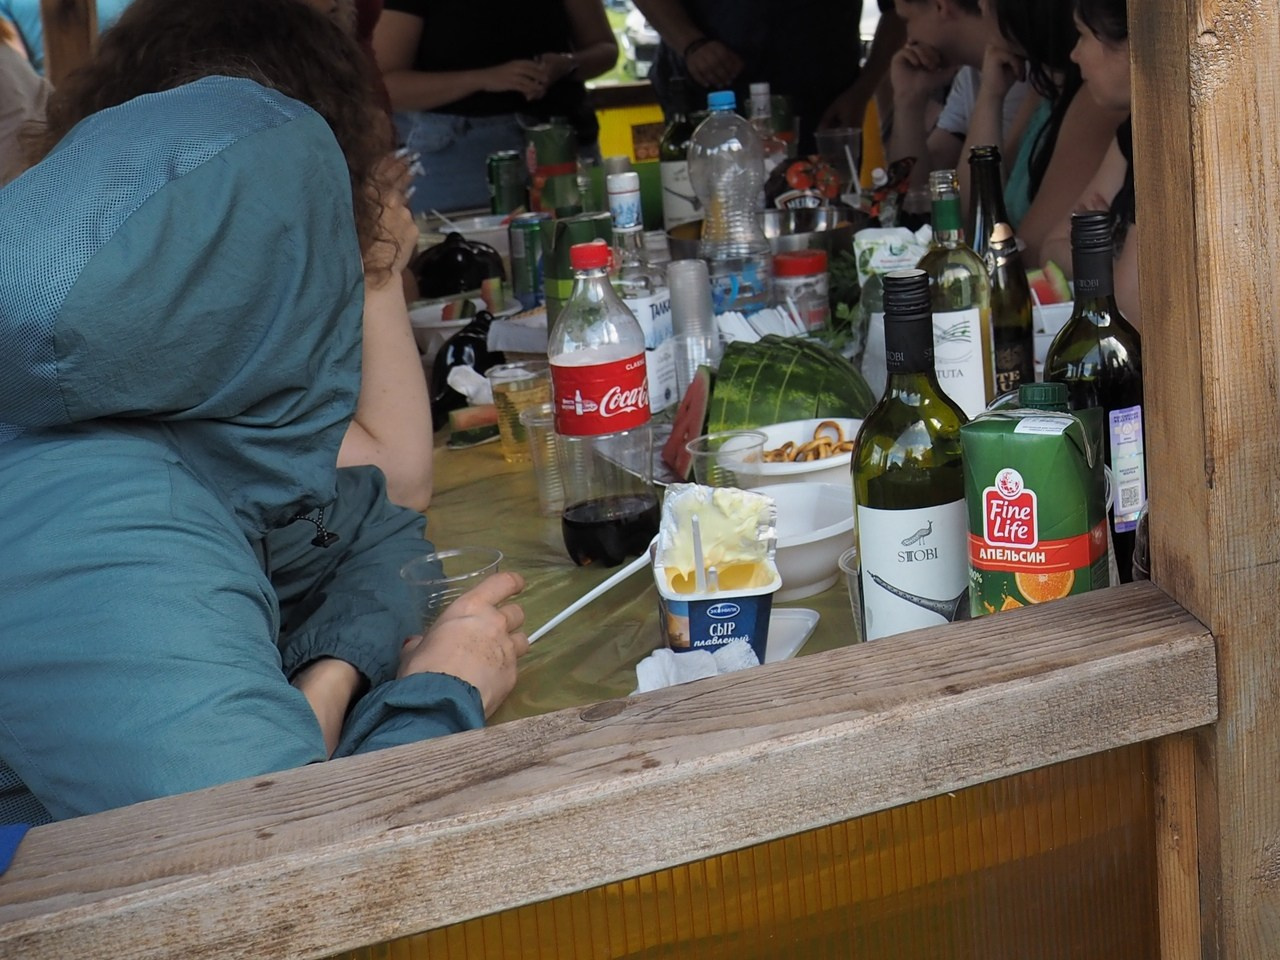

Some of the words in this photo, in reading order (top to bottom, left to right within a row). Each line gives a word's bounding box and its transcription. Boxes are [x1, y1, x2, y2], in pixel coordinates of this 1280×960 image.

[990, 499, 1031, 521] Fine
[993, 516, 1029, 542] Life
[897, 547, 938, 563] STOBI
[979, 547, 1046, 563] АПЕЛЬСИН
[709, 622, 735, 637] СЫР
